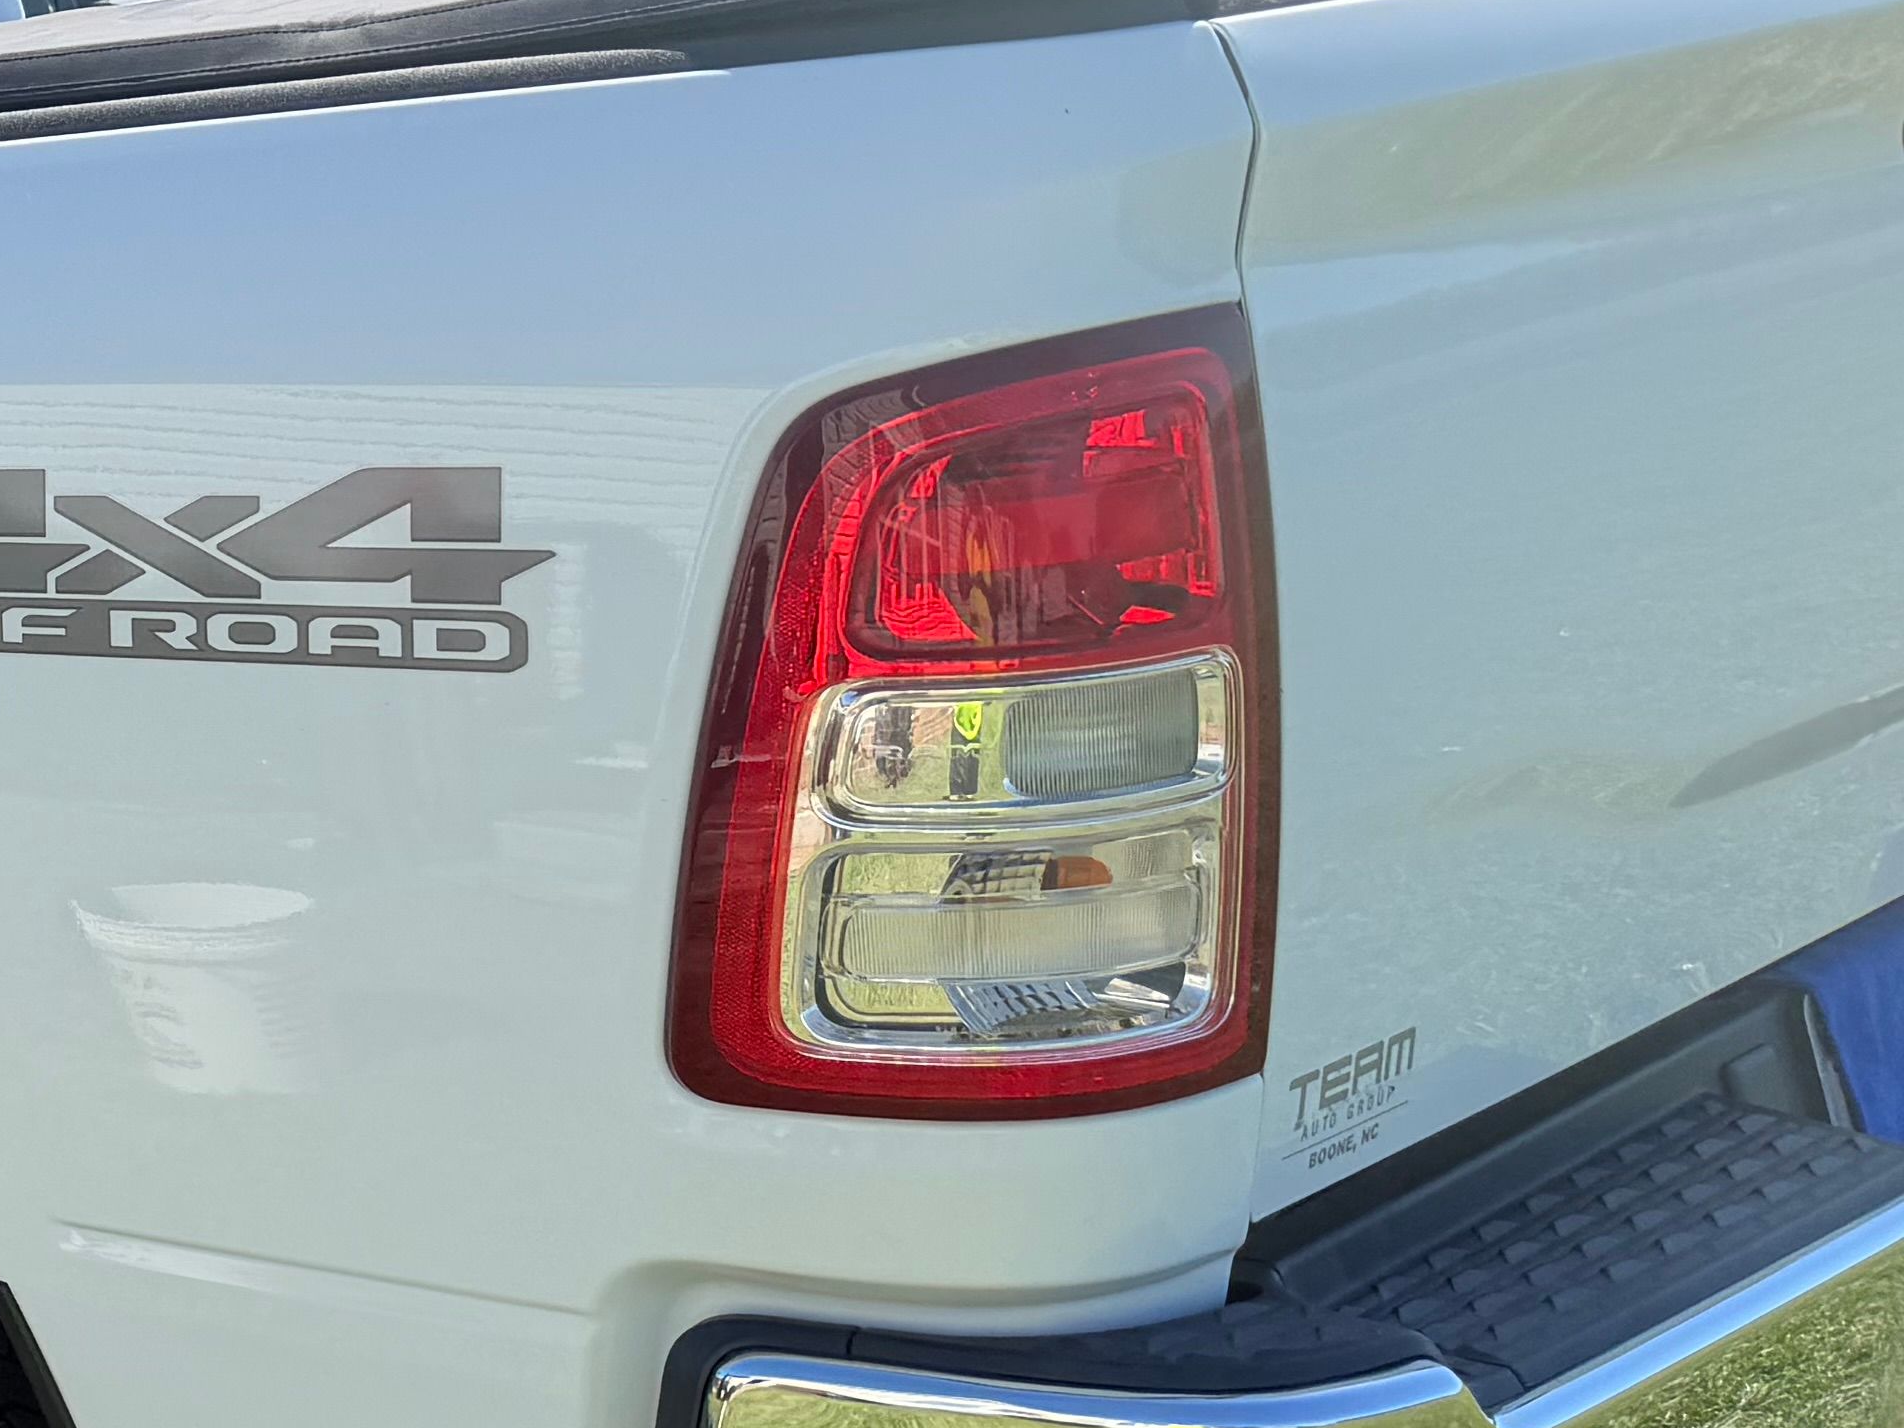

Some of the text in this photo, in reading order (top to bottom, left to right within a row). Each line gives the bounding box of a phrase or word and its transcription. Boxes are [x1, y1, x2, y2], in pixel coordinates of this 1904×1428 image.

[109, 609, 510, 663] ROAD
[1289, 1026, 1416, 1132] TEAM
[1300, 1085, 1395, 1142] AUTO GROUP
[1308, 1123, 1379, 1169] BOONE, NC
